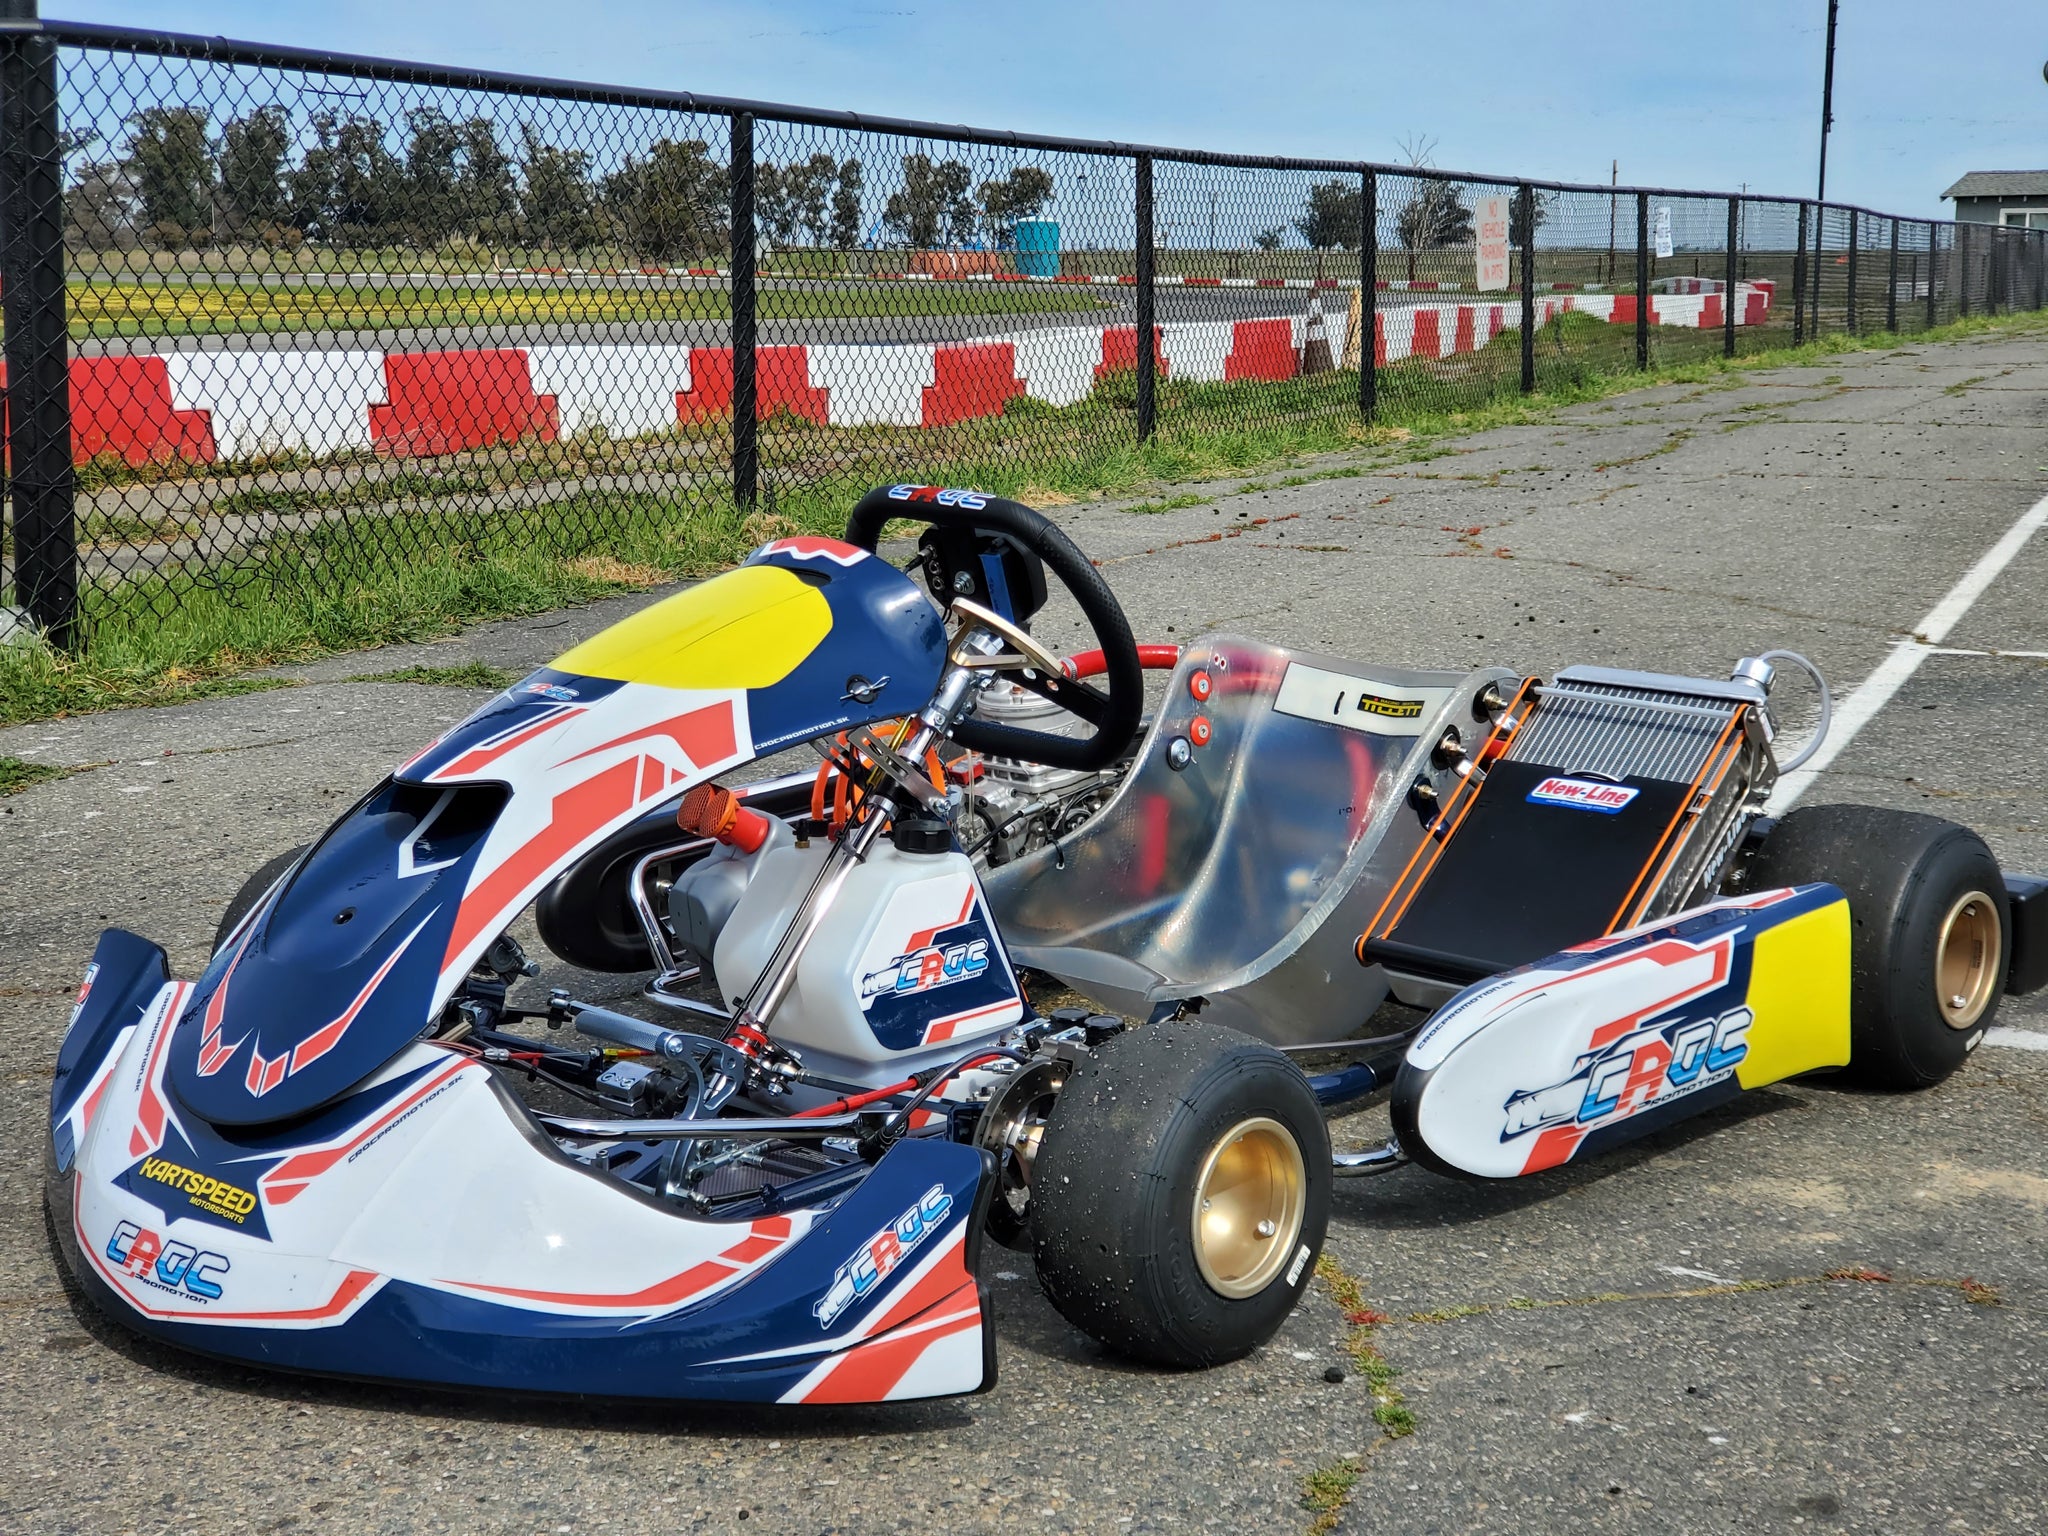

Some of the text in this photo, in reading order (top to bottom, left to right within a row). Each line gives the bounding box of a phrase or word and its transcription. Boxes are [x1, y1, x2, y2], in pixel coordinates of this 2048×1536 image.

[1488, 201, 1498, 218] NO
[1481, 221, 1505, 239] VEHICLE
[1481, 242, 1506, 260] PARKING
[1484, 263, 1504, 282] IN PITS
[888, 484, 998, 511] CROC
[1361, 698, 1423, 716] TILLETT
[1536, 779, 1630, 804] New-Line
[895, 939, 990, 992] CROC
[1577, 1006, 1754, 1125] CROC
[138, 1156, 257, 1215] KARTSPEED
[188, 1196, 246, 1225] MOTORSPORTS
[850, 1183, 954, 1296] CROC
[106, 1219, 232, 1301] CROC
